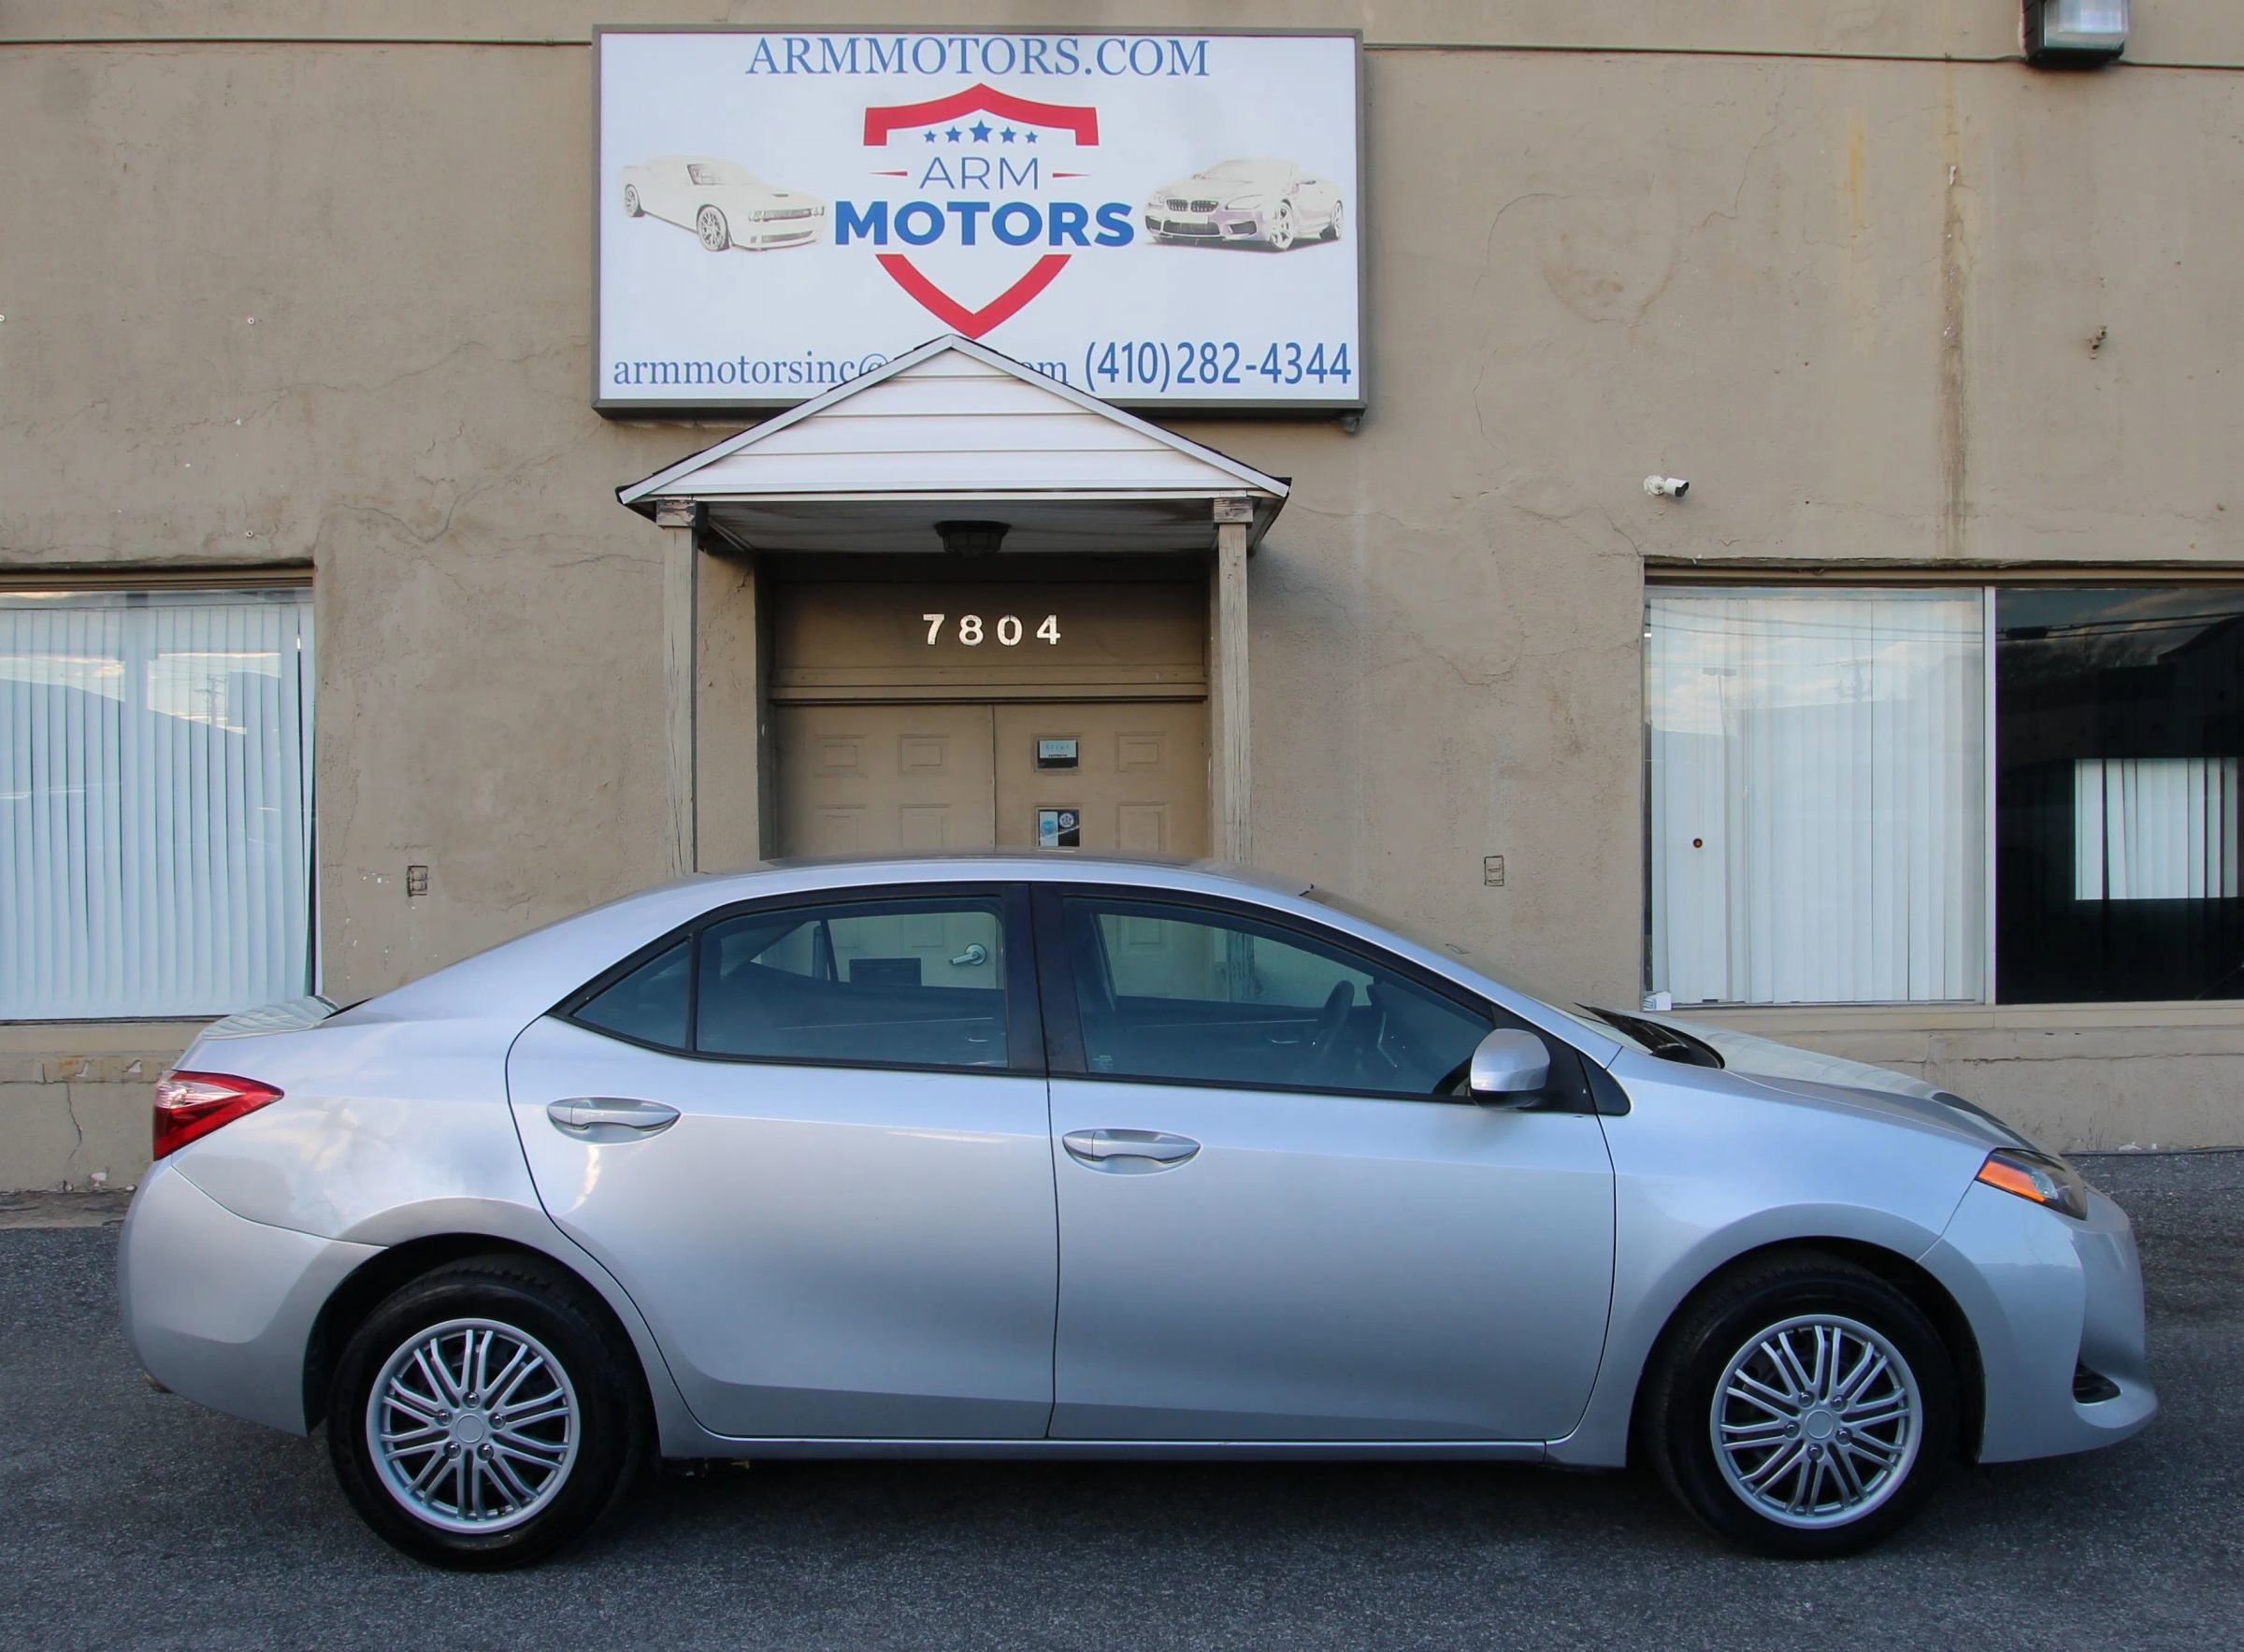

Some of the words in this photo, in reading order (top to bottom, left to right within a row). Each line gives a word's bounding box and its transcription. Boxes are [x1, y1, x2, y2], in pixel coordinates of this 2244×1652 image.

[746, 36, 1211, 77] ARMMOTORS.COM
[919, 156, 1040, 191] ARM
[834, 200, 1135, 248] MOTORS
[1085, 340, 1352, 394] (410)282-4344
[922, 613, 1062, 647] 7804
